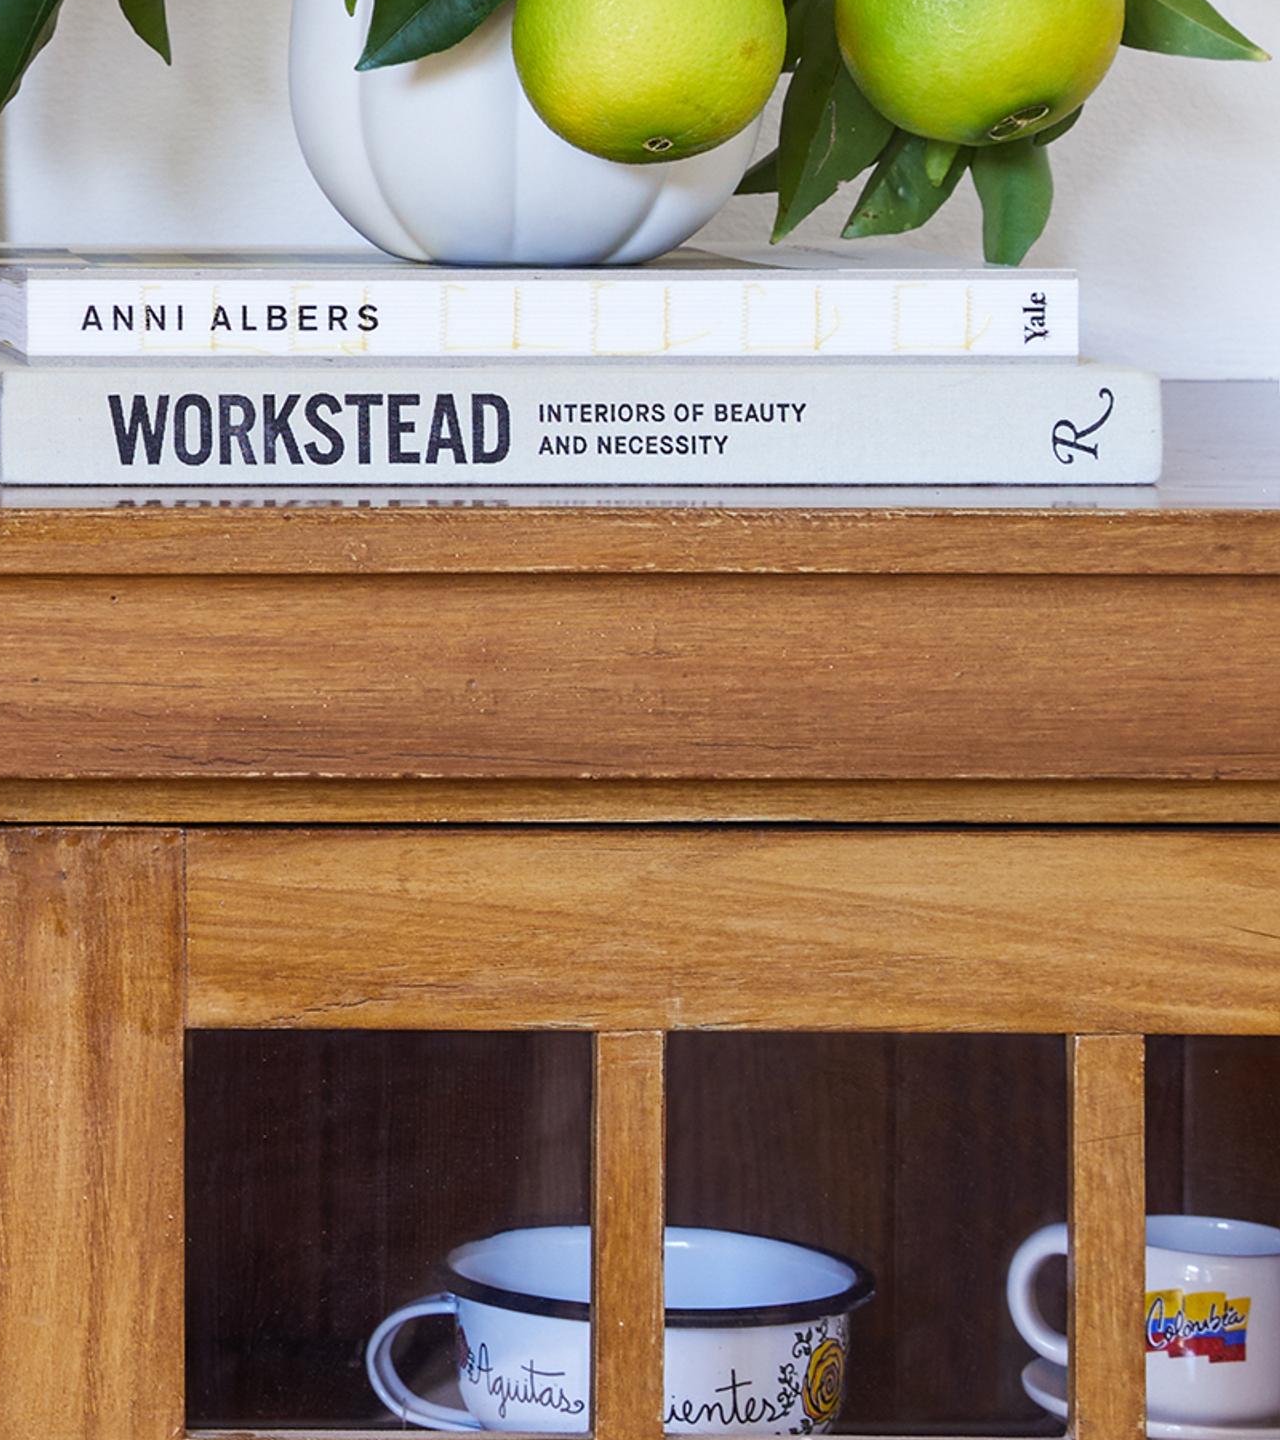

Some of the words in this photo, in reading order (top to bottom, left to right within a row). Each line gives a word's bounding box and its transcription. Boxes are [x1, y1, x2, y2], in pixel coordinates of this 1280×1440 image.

[81, 305, 184, 331] ANNI
[210, 304, 379, 332] ALBERS
[1022, 291, 1050, 345] Yale
[107, 393, 511, 466] WORKSTEAD
[539, 402, 666, 423] INTERIORS
[674, 402, 705, 423] OF
[715, 402, 807, 423] BEAUTY
[1052, 387, 1115, 465] R
[538, 435, 588, 456] AND
[597, 435, 729, 456] NECESSITY
[1146, 1297, 1246, 1348] Colombia
[663, 1368, 785, 1426] ientes
